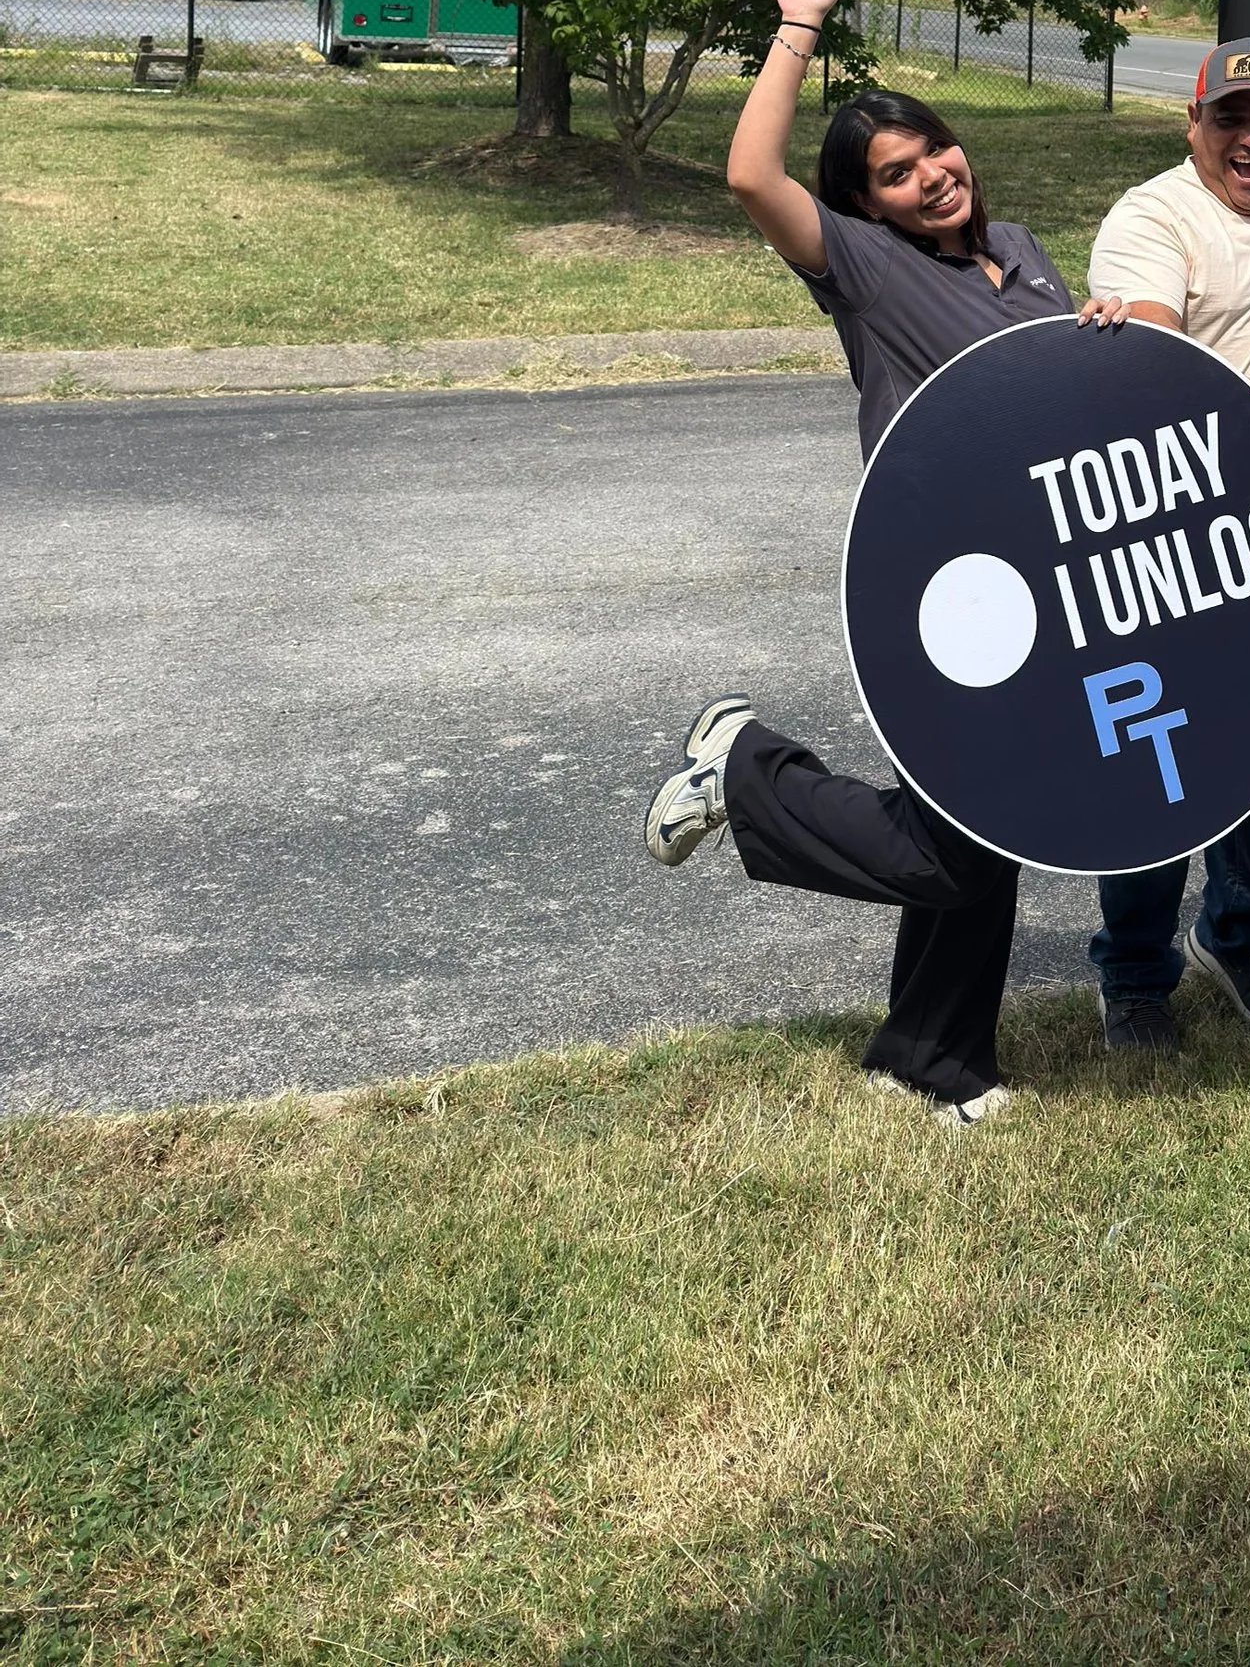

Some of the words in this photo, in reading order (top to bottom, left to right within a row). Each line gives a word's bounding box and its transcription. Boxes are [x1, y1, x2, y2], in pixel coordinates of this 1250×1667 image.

[1028, 411, 1227, 544] TODAY
[1053, 563, 1088, 650] I
[1082, 661, 1189, 804] PT
